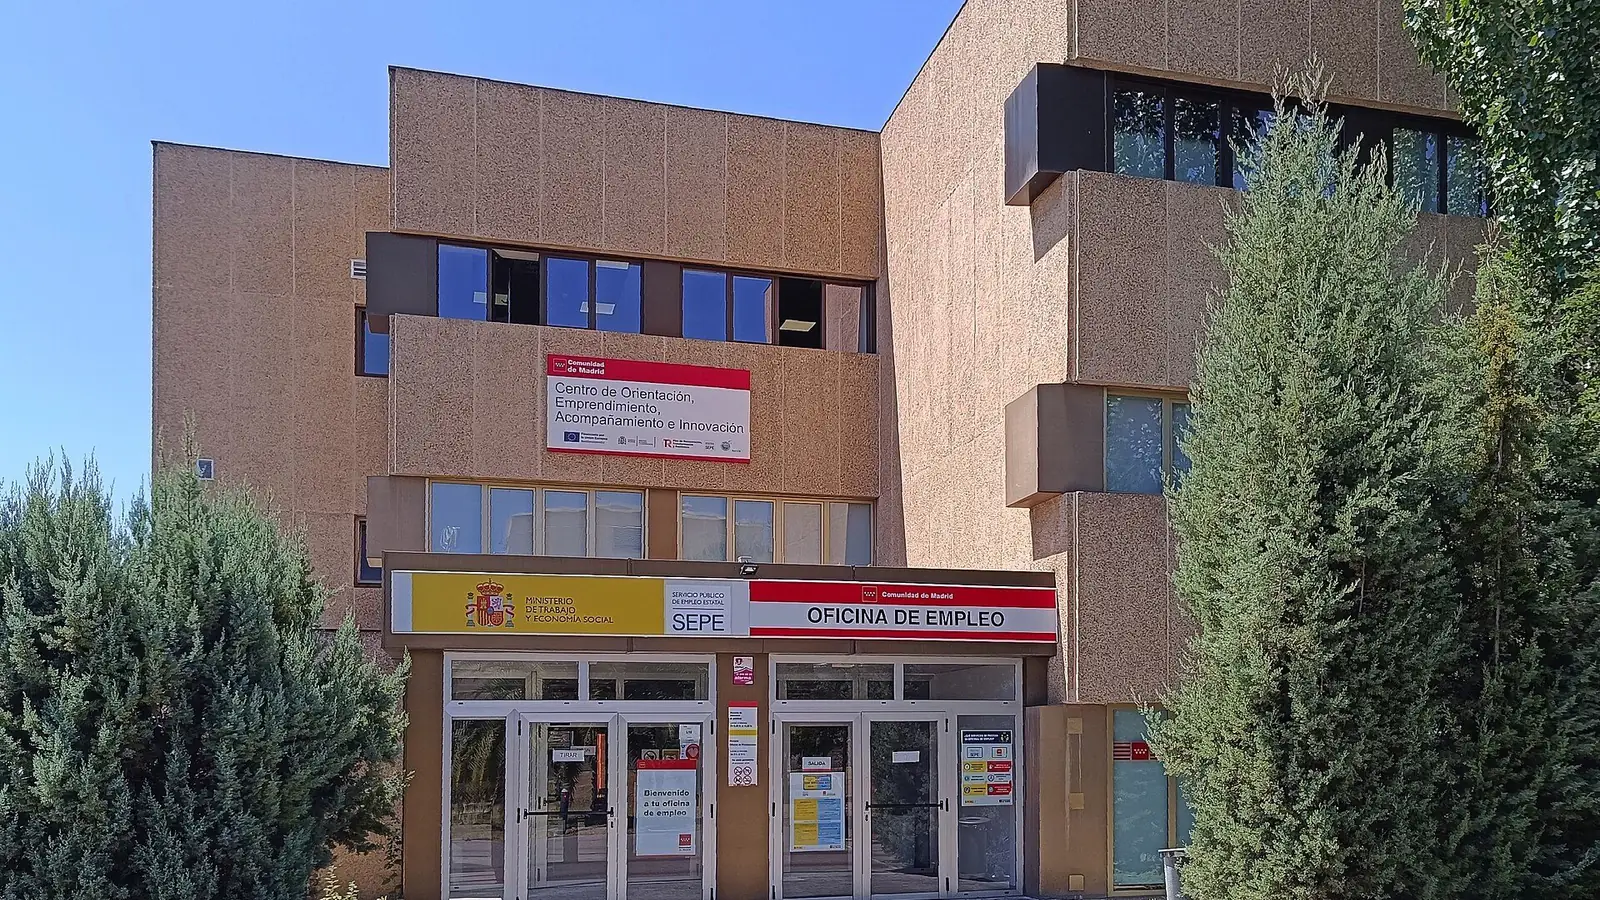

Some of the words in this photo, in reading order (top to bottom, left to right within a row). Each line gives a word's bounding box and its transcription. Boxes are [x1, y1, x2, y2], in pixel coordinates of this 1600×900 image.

[568, 360, 605, 368] Comunidad
[579, 367, 605, 375] Madrid
[555, 382, 598, 396] Centro
[601, 386, 617, 397] de
[621, 386, 695, 404] Orientación,
[555, 397, 661, 415] Emprendimiento,
[555, 411, 664, 428] Acompañamiento
[667, 420, 675, 429] e
[679, 419, 744, 433] Innovación
[882, 591, 919, 599] Comunidad
[931, 592, 954, 600] Madrid
[525, 596, 573, 605] MINISTERIO
[525, 605, 537, 613] DE
[538, 606, 576, 615] TRABAJO
[534, 615, 581, 623] ECONOMÍA
[583, 616, 614, 624] SOCIAL
[807, 606, 888, 624] OFICINA
[894, 609, 920, 625] DE
[926, 610, 1005, 627] EMPLEO
[672, 613, 725, 631] SEPE
[644, 789, 690, 797] Bienvenido
[643, 809, 654, 817] de
[656, 809, 687, 818] empleo
